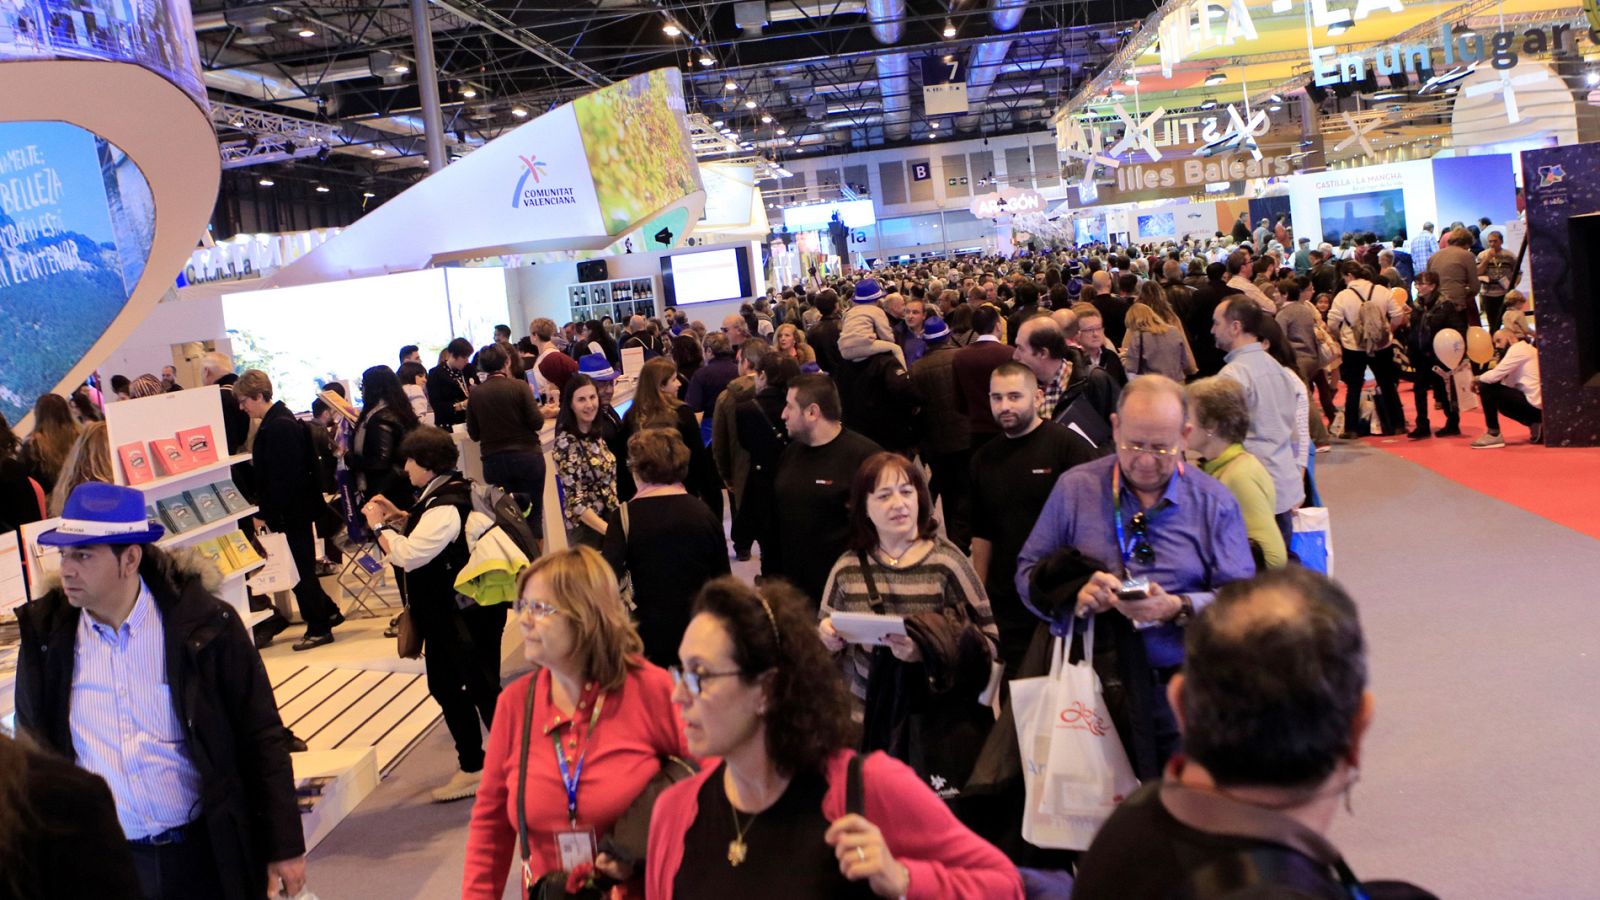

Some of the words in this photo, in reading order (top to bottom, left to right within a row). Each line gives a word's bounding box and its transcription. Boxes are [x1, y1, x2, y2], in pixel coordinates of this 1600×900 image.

[1312, 45, 1367, 87] En
[1376, 44, 1431, 78] un
[1441, 23, 1570, 70] lugar
[946, 61, 959, 80] 7
[916, 165, 928, 179] B
[1117, 165, 1176, 192] Illes
[1184, 155, 1290, 184] Balears
[1315, 179, 1350, 190] CASTILLA
[1367, 172, 1402, 183] MANCHA
[0, 167, 64, 215] BELLEZA
[524, 188, 574, 198] COMUNITAT
[524, 196, 576, 207] VALENCIANA
